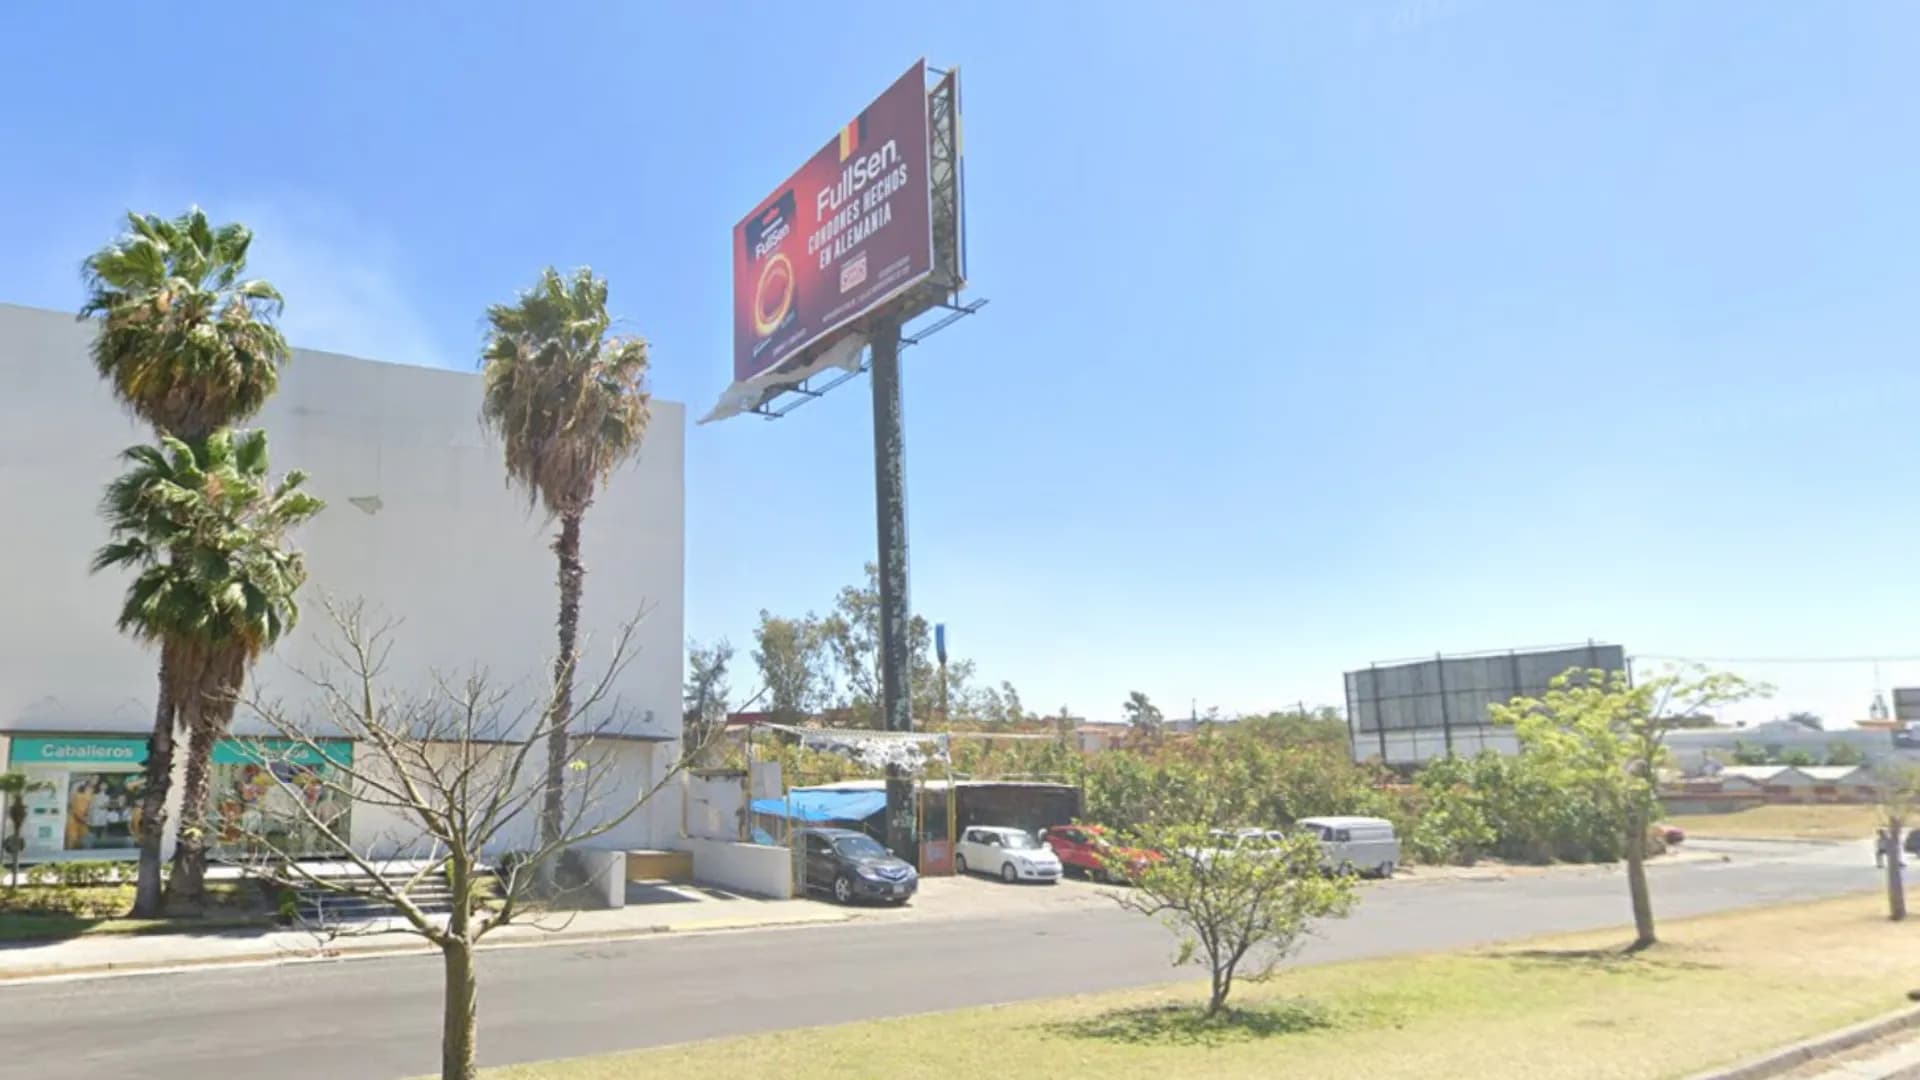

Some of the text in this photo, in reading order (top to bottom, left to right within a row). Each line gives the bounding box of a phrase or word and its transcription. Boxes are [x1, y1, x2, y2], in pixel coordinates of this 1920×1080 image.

[807, 199, 860, 255] CONDONES
[862, 163, 908, 213] HECHOS
[816, 139, 897, 222] FullSen
[819, 244, 832, 270] EN
[833, 201, 892, 260] ALEMANIA
[42, 743, 134, 759] Caballeros
